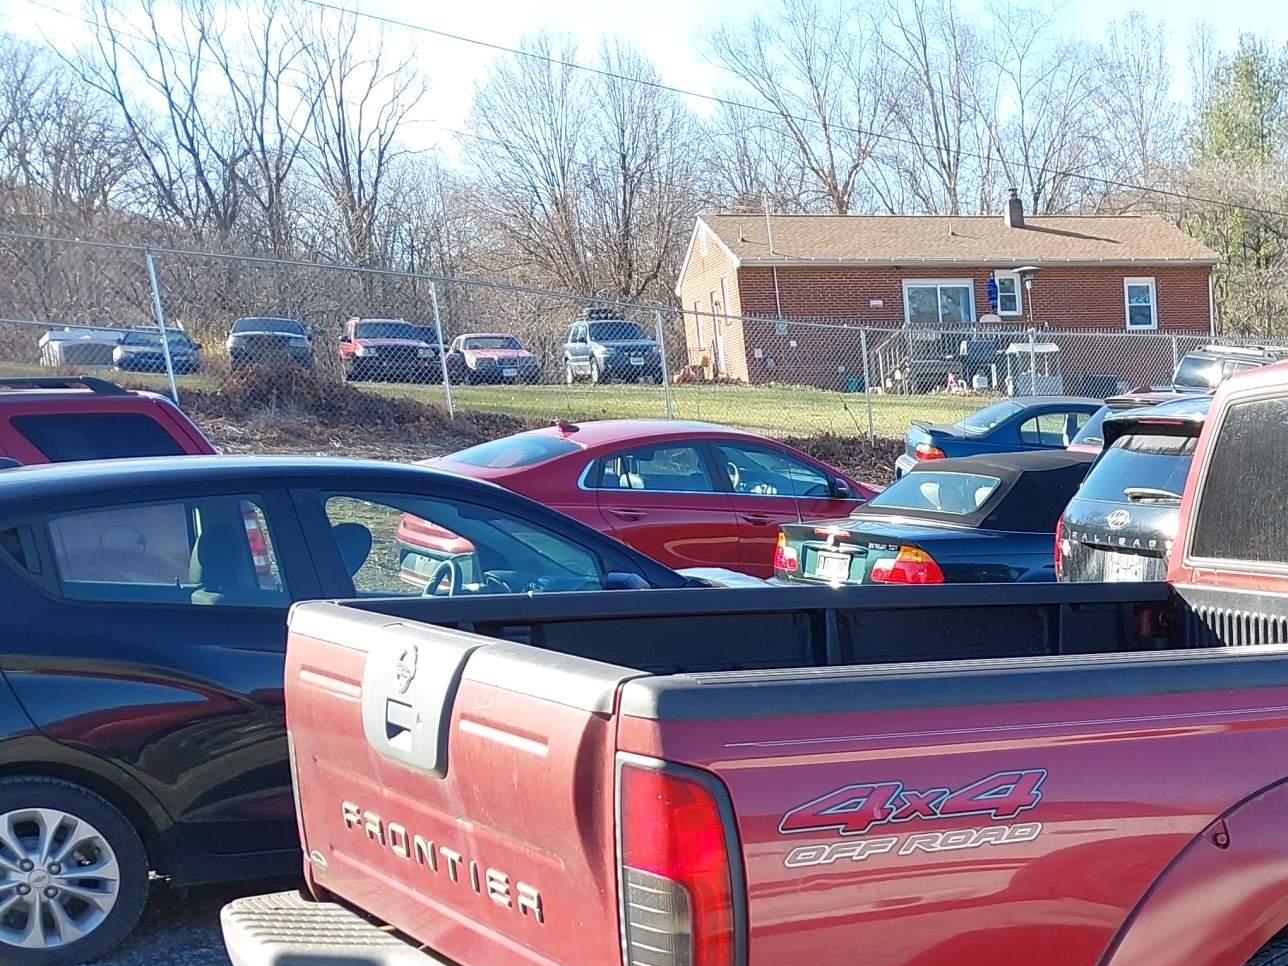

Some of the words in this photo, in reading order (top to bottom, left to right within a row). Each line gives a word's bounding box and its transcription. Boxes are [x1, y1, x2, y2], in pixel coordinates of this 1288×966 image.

[778, 768, 1047, 836] 4x4
[341, 800, 545, 925] FRONTIER
[783, 836, 898, 868] OFF
[898, 822, 1043, 856] ROAD
